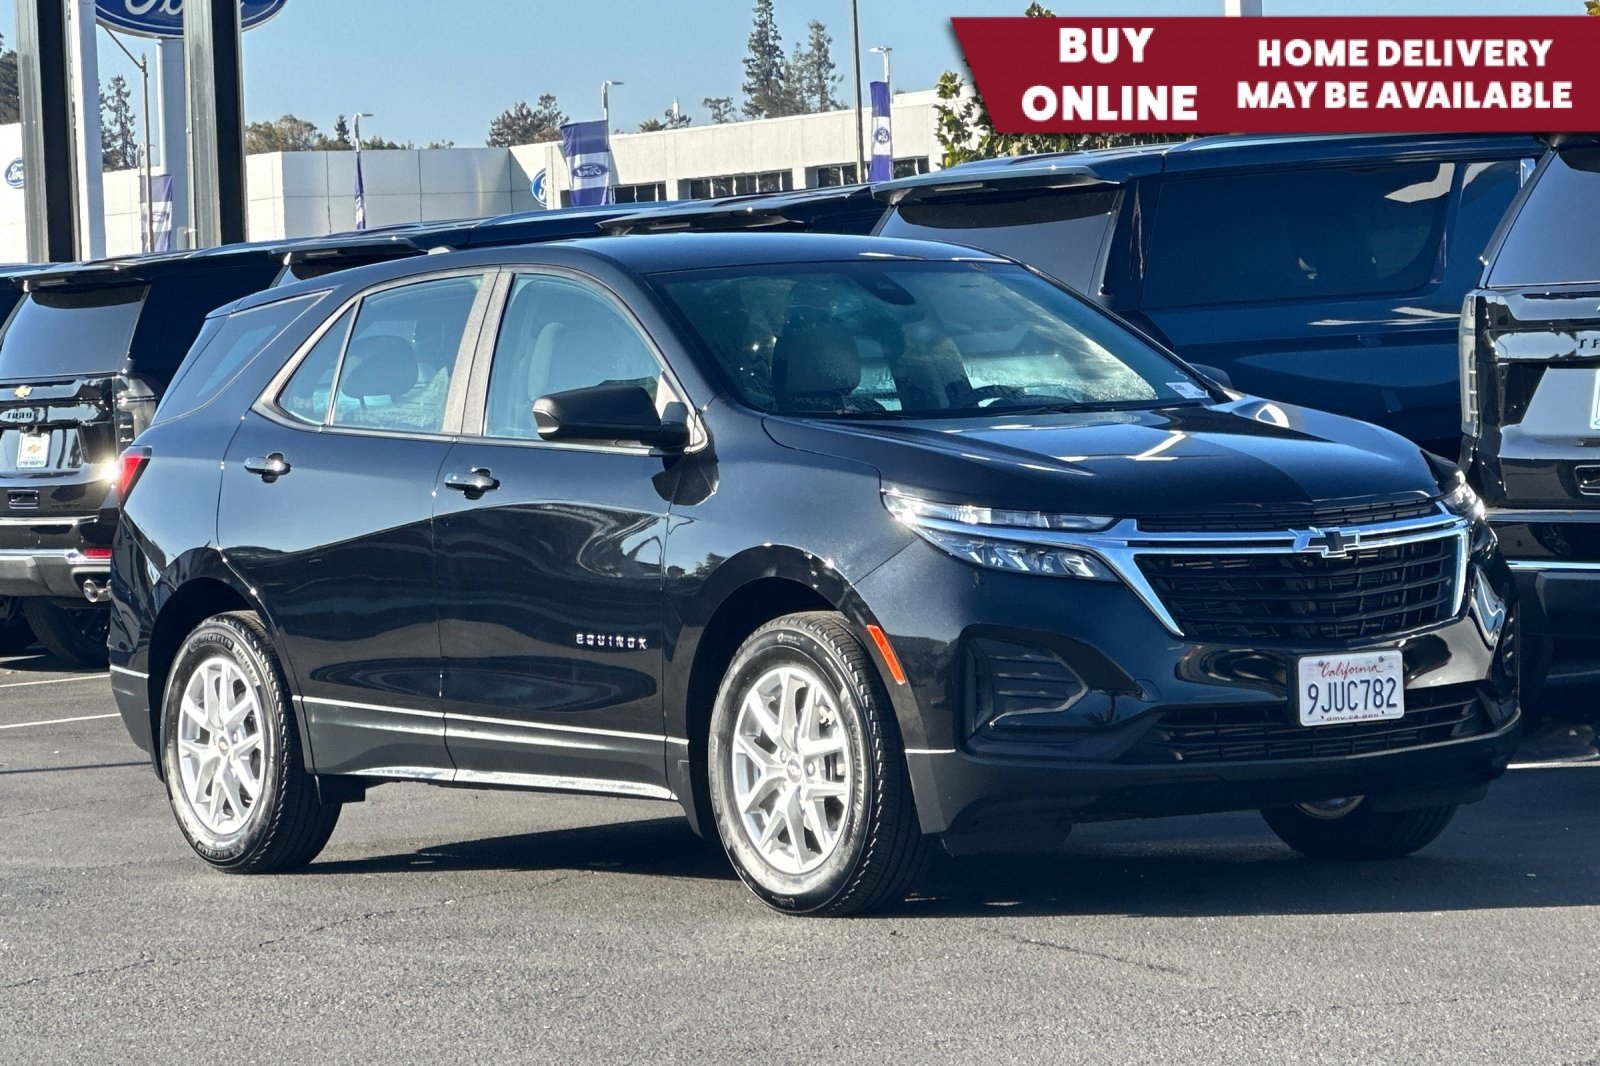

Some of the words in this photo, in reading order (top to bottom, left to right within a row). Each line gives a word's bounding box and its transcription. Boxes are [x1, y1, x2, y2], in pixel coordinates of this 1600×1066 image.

[576, 633, 647, 650] EQUINOX
[1321, 661, 1384, 680] California
[1307, 677, 1398, 715] 9JUC782
